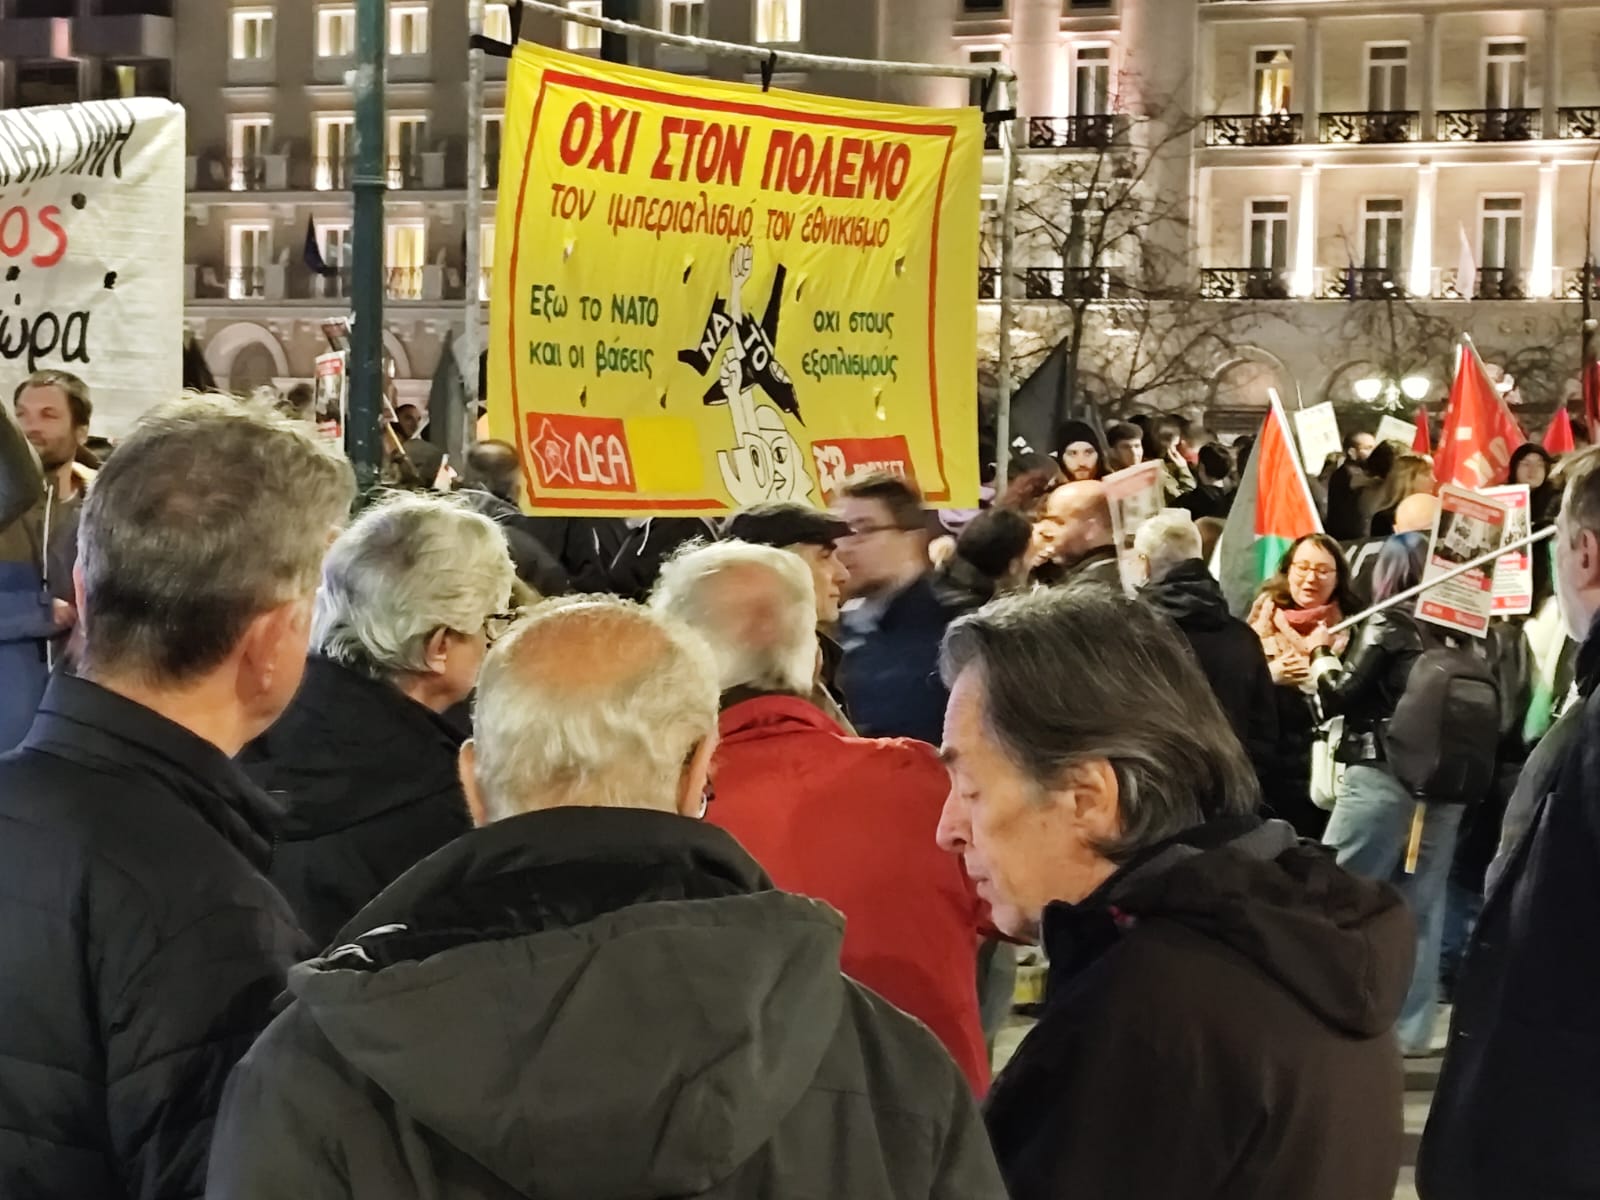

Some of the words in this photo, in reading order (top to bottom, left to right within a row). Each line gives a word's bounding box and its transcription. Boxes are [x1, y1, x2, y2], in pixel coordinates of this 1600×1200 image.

[560, 101, 640, 174] ΟΧΙ
[651, 117, 750, 186] ΣΤΟΝ
[761, 130, 911, 201] ΠΟΛΕΜΟ
[551, 183, 596, 220] τον
[767, 208, 796, 241] τον
[0, 293, 91, 373] ώρα
[579, 296, 602, 322] το
[611, 293, 659, 327] ΝΑΤΟ
[529, 341, 562, 367] και
[569, 345, 584, 369] οι
